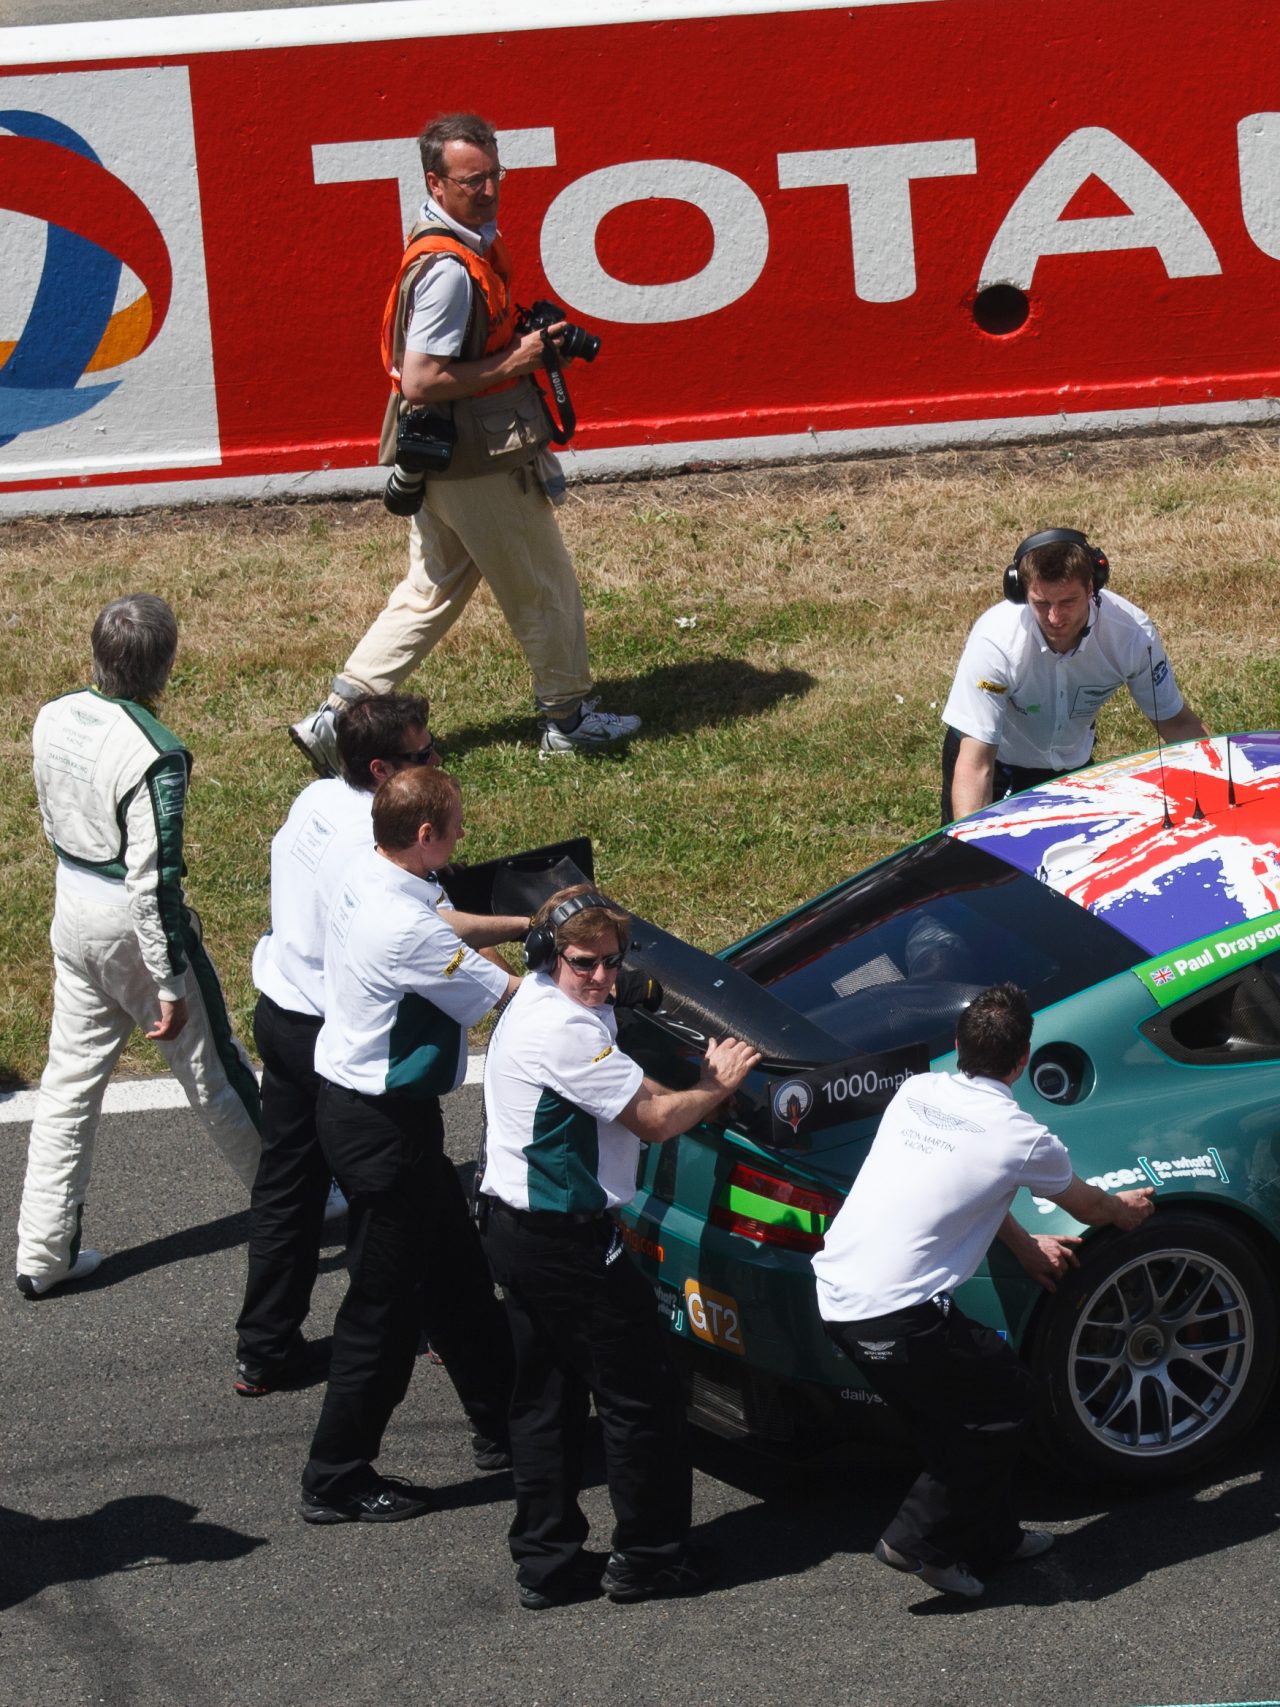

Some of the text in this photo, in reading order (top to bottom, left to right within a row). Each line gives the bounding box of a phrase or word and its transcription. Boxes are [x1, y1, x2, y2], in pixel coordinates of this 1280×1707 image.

[551, 371, 566, 404] Canon
[1174, 948, 1214, 977] Paul
[821, 1067, 914, 1104] 1000mph
[1151, 1154, 1212, 1172] So what?
[687, 1292, 740, 1345] GT2
